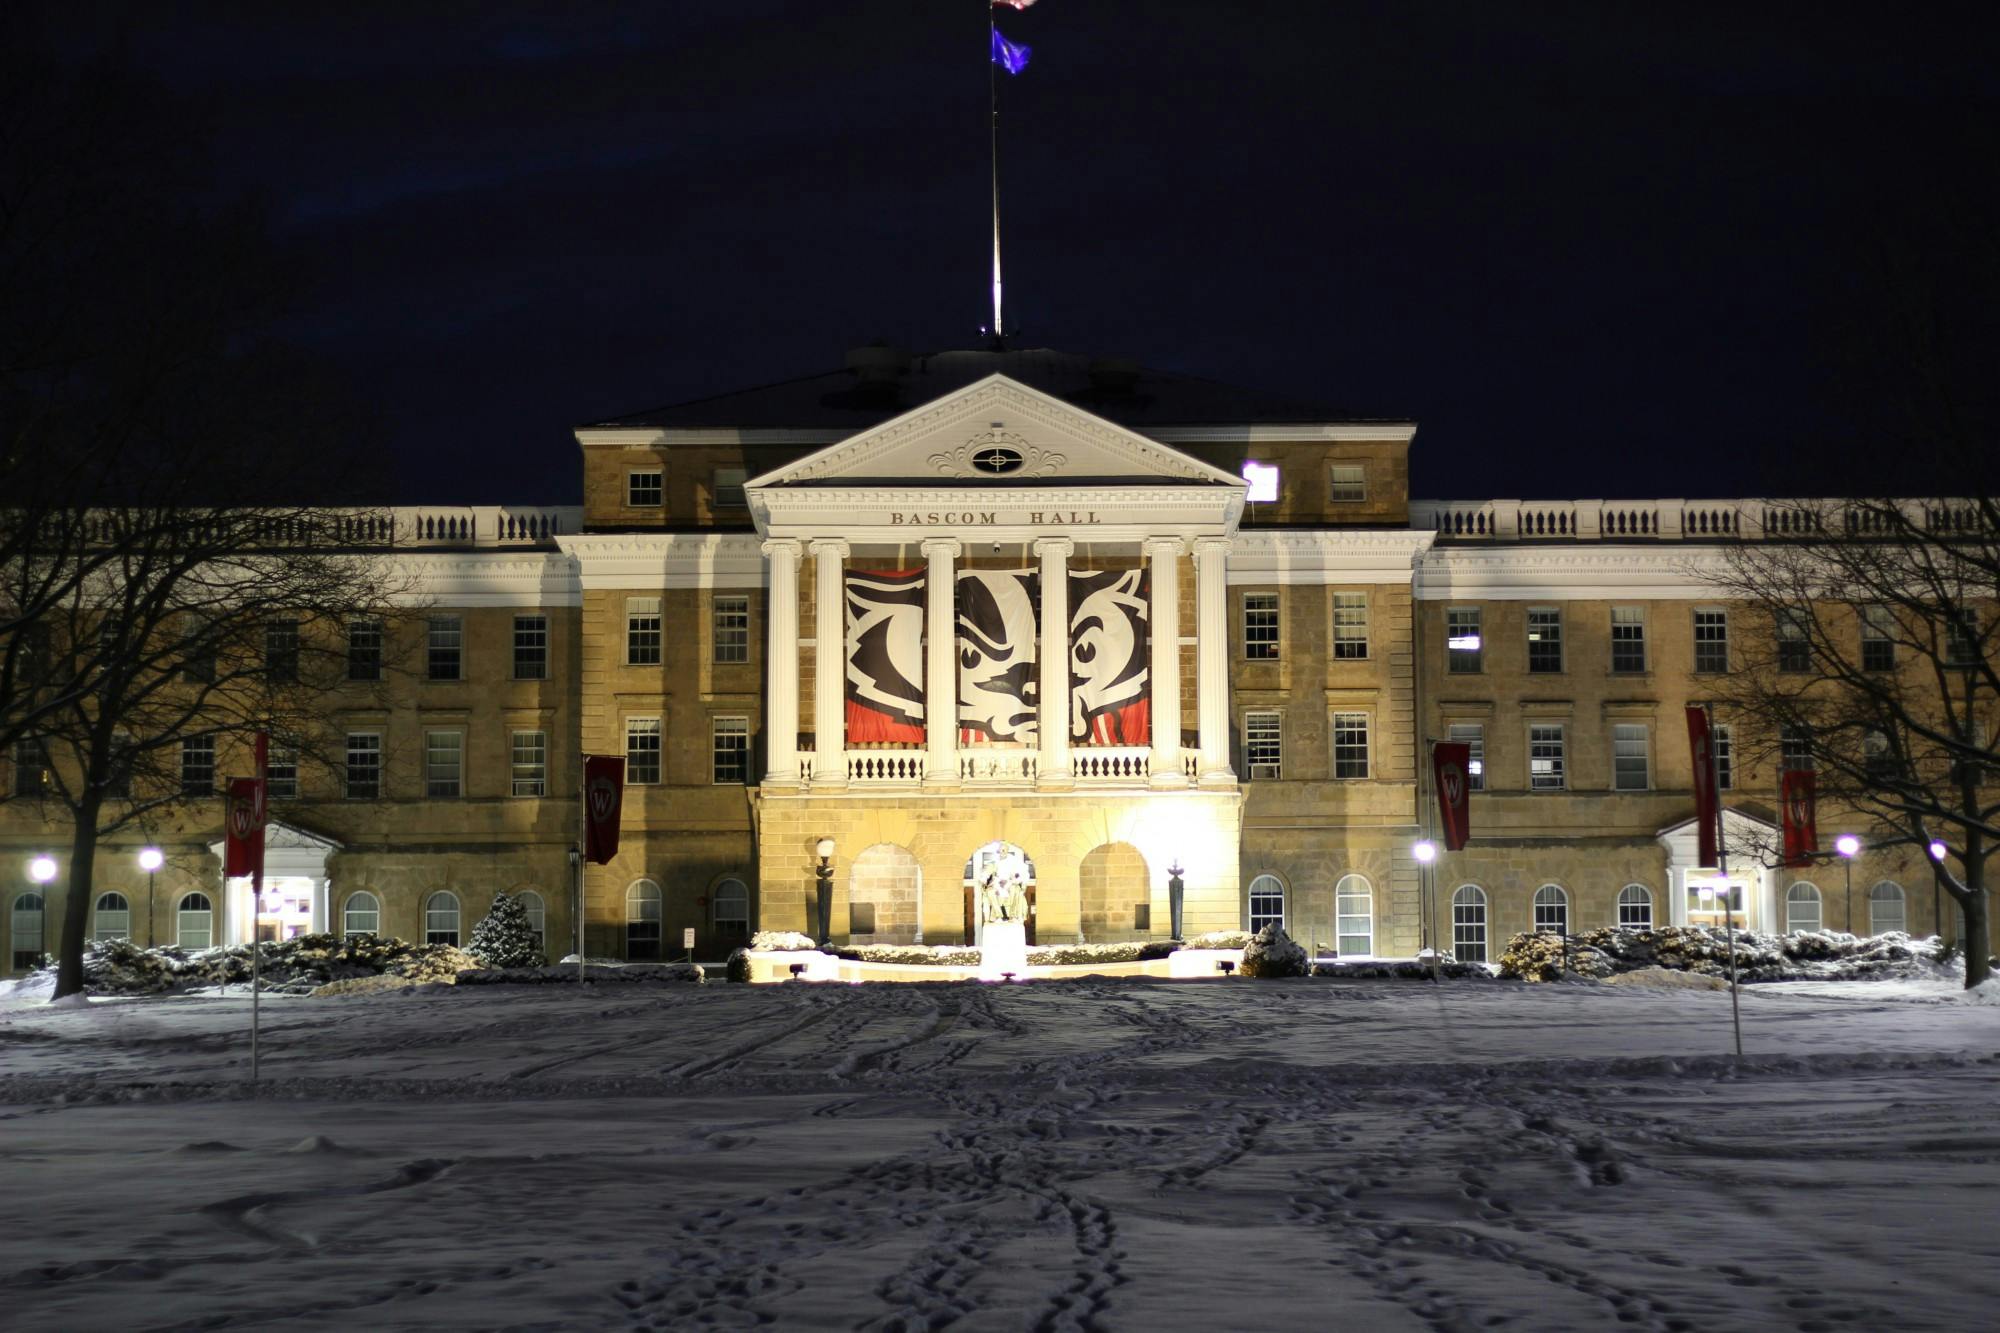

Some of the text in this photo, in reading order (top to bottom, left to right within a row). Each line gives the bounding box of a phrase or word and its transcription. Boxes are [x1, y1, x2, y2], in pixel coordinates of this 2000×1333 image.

[891, 511, 1101, 525] BASCOM HALL
[1444, 778, 1459, 800] W
[593, 791, 610, 811] W
[236, 811, 250, 831] W
